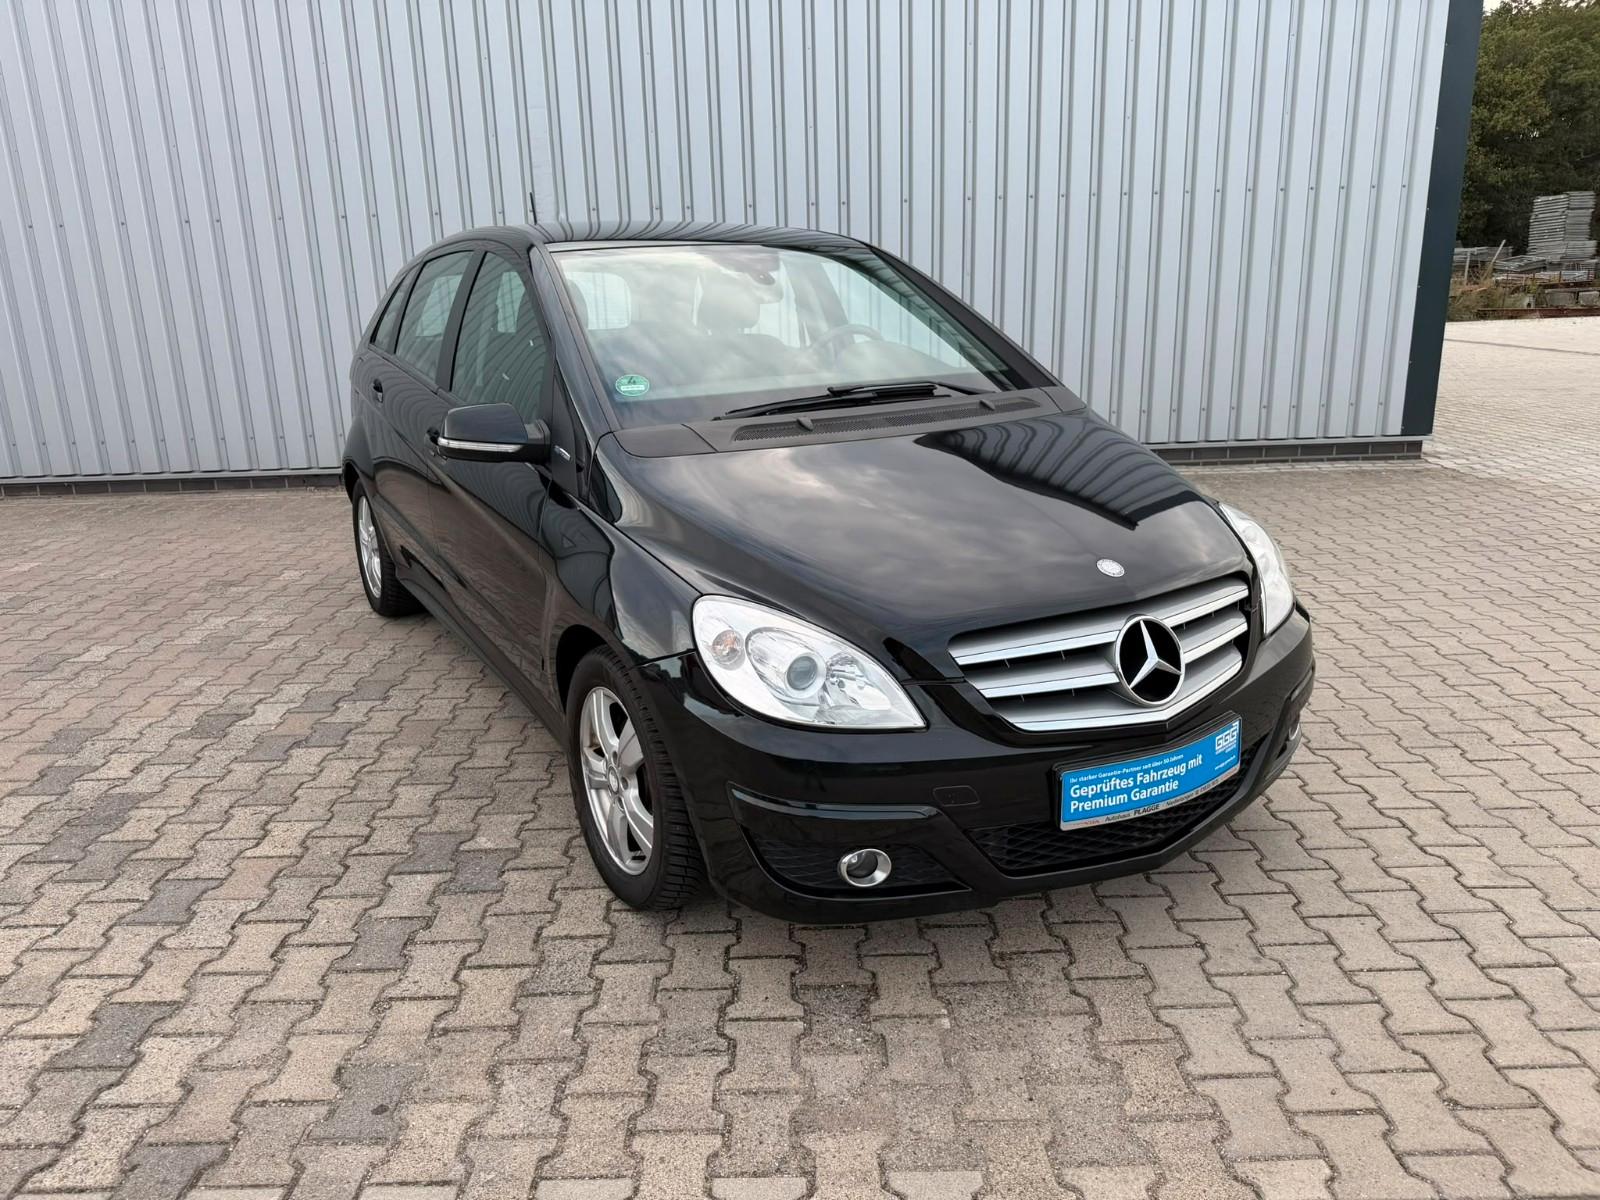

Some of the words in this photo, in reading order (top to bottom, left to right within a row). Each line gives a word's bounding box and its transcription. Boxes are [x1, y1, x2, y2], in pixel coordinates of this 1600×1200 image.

[1215, 729, 1237, 751] GGG
[1070, 776, 1134, 798] Geprüftes
[1136, 762, 1187, 786] Fahrzeug
[1188, 754, 1203, 770] mit
[1079, 774, 1097, 782] starker
[1098, 766, 1141, 778] Garantie-Partner
[1170, 754, 1184, 762] Jahren
[1070, 792, 1128, 813] Premium
[1131, 780, 1179, 801] Garantie
[1105, 812, 1131, 822] Autohaus
[1133, 804, 1160, 816] PLAGGE
